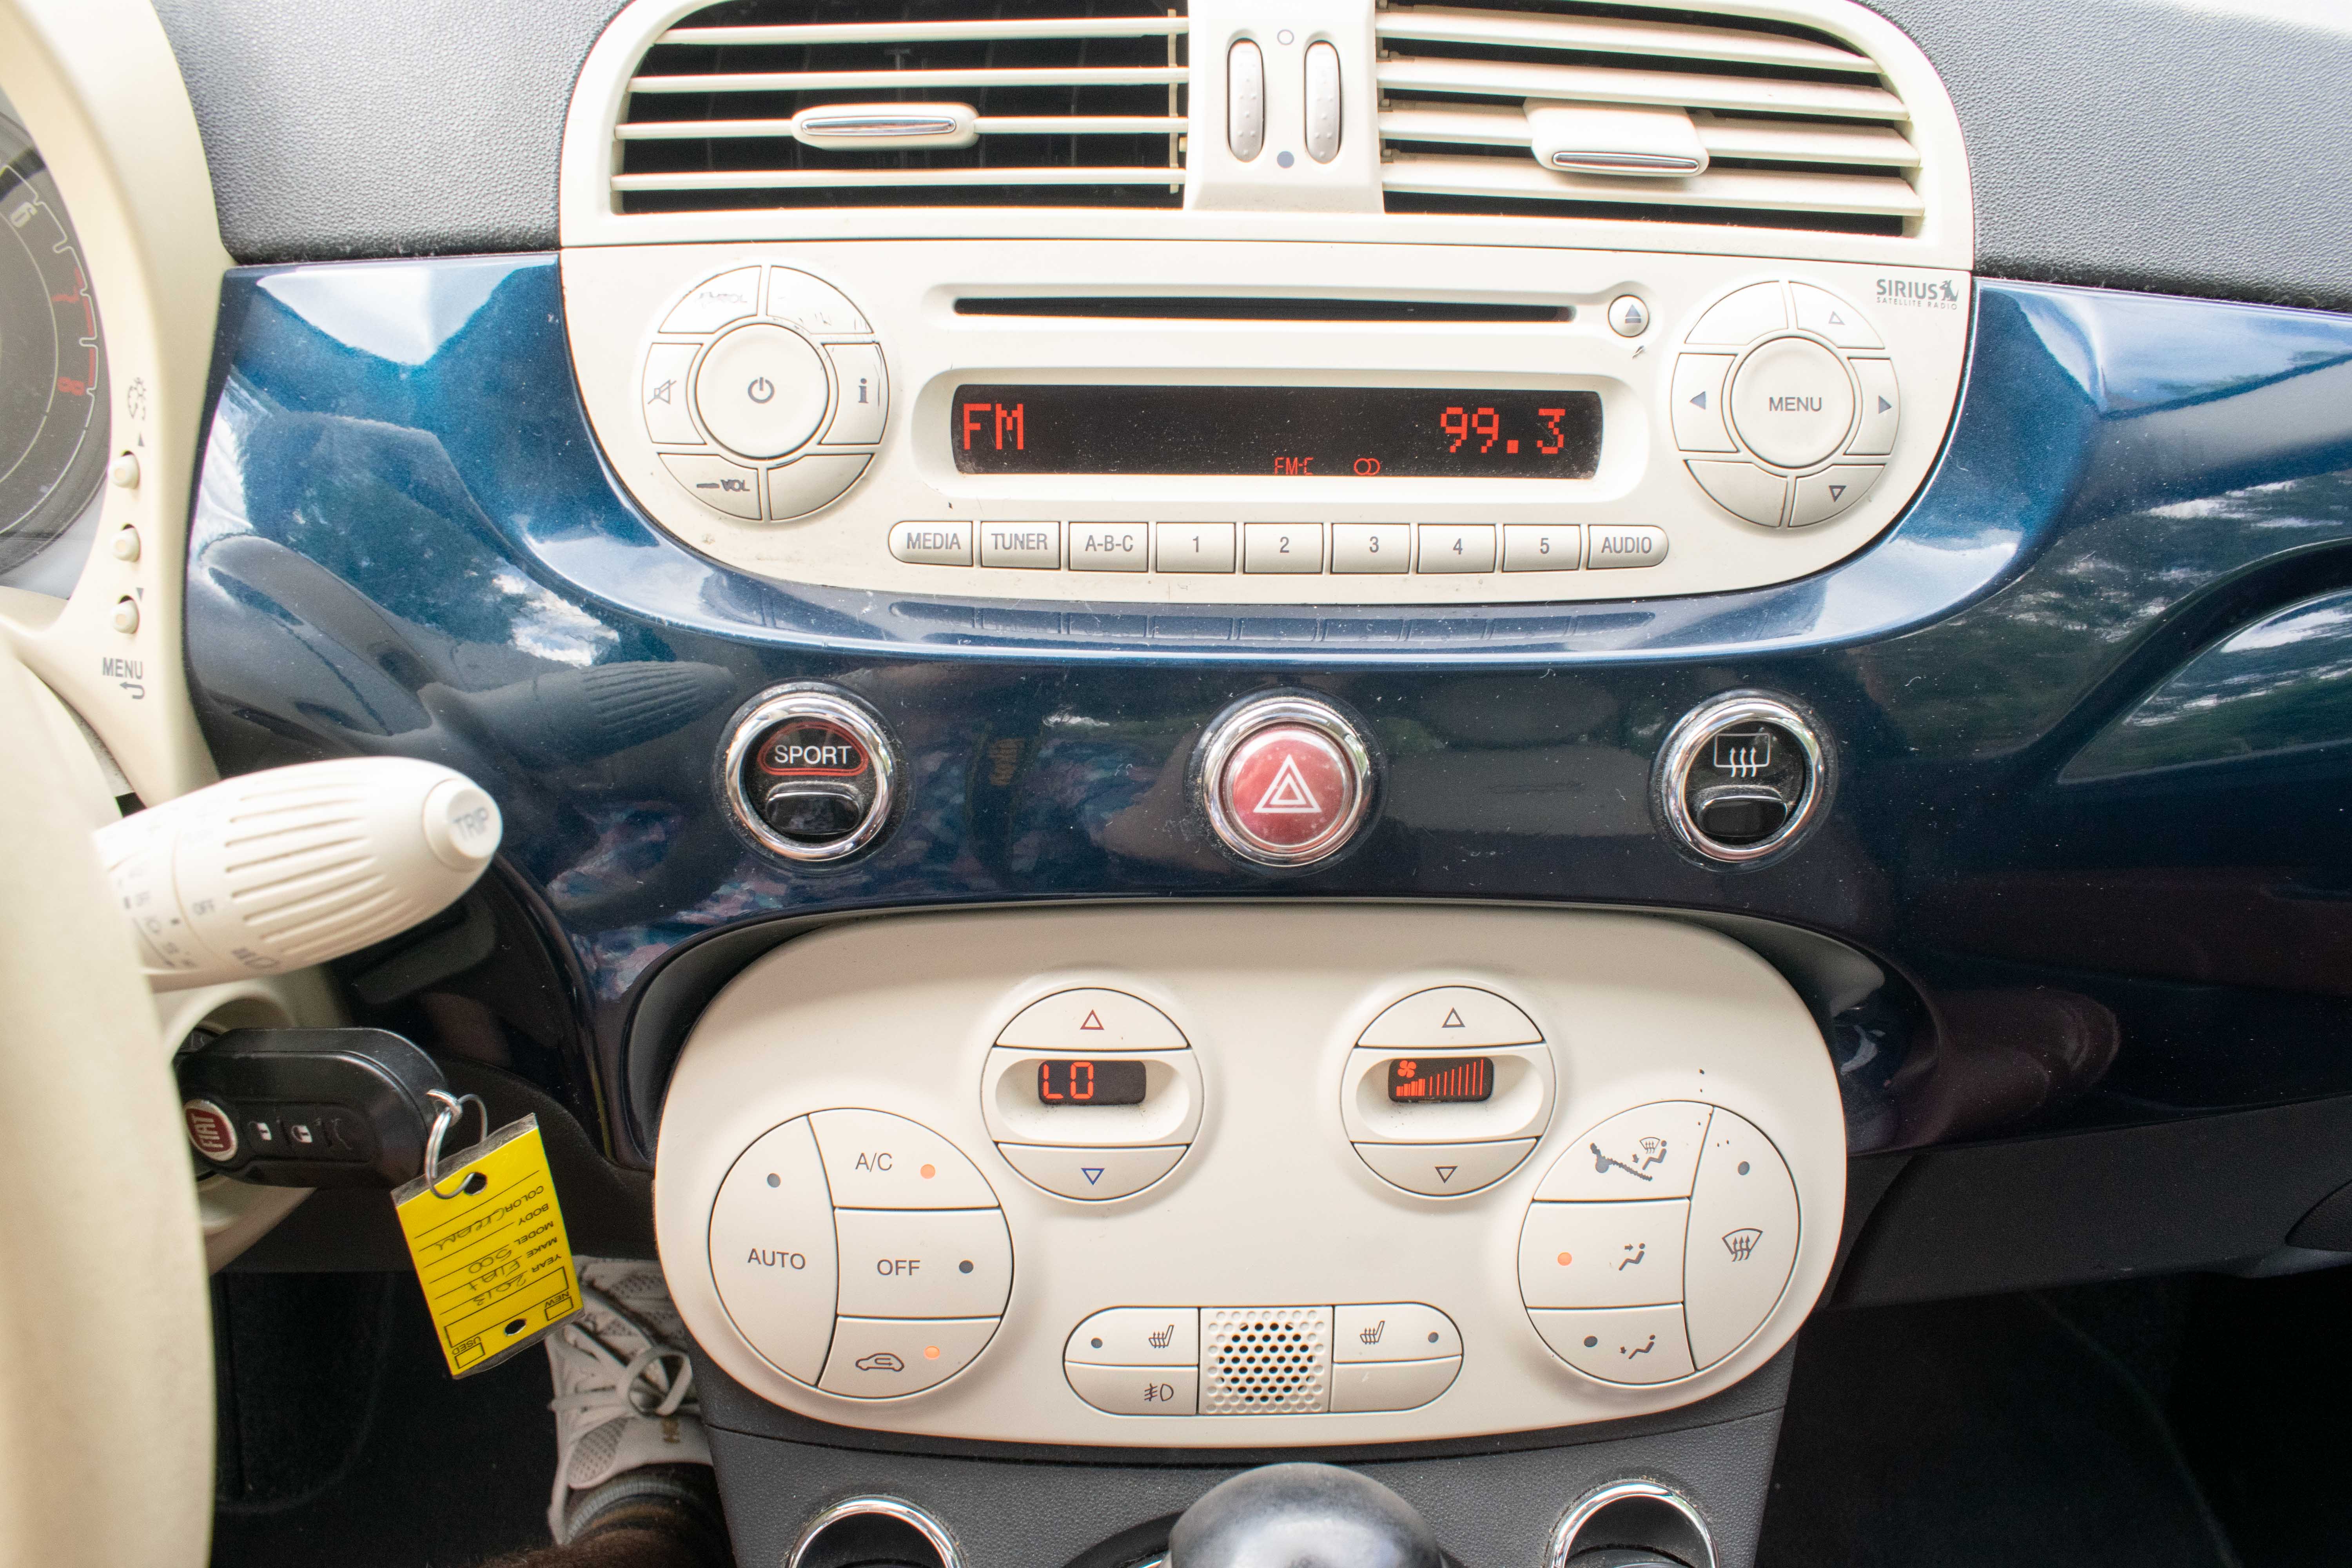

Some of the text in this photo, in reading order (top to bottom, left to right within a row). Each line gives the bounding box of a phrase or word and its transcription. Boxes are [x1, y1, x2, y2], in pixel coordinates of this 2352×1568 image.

[10, 202, 38, 227] 6
[1876, 278, 1938, 300] SIRIUS
[1877, 297, 1957, 310] SATELLITE RADIO
[57, 377, 85, 396] 8
[1769, 396, 1822, 412] MENU
[963, 403, 1024, 450] FM
[1440, 407, 1566, 454] 99.3
[906, 532, 962, 550] MEDIA
[991, 533, 1048, 550] TUNER
[1085, 535, 1134, 552] A-B-C
[1192, 535, 1200, 553] 1
[1279, 536, 1290, 553] 2
[1369, 536, 1379, 553] 3
[1453, 538, 1463, 555] 4
[1540, 537, 1550, 555] 5
[1601, 536, 1652, 554] AUDIO
[102, 657, 143, 680] MENU
[774, 745, 852, 764] SPORT
[452, 807, 489, 841] TRIP
[191, 1113, 224, 1148] FIAT
[855, 1152, 893, 1172] A/C
[505, 1185, 544, 1212] COLOR
[518, 1203, 549, 1226] BODY
[468, 1220, 554, 1274] MODEL 500
[526, 1236, 557, 1258] MAKE
[747, 1248, 806, 1270] AUTO
[877, 1259, 920, 1276] OFF
[473, 1254, 562, 1306] YEAR 2013
[544, 1291, 569, 1308] NEW
[451, 1336, 481, 1356] USED
